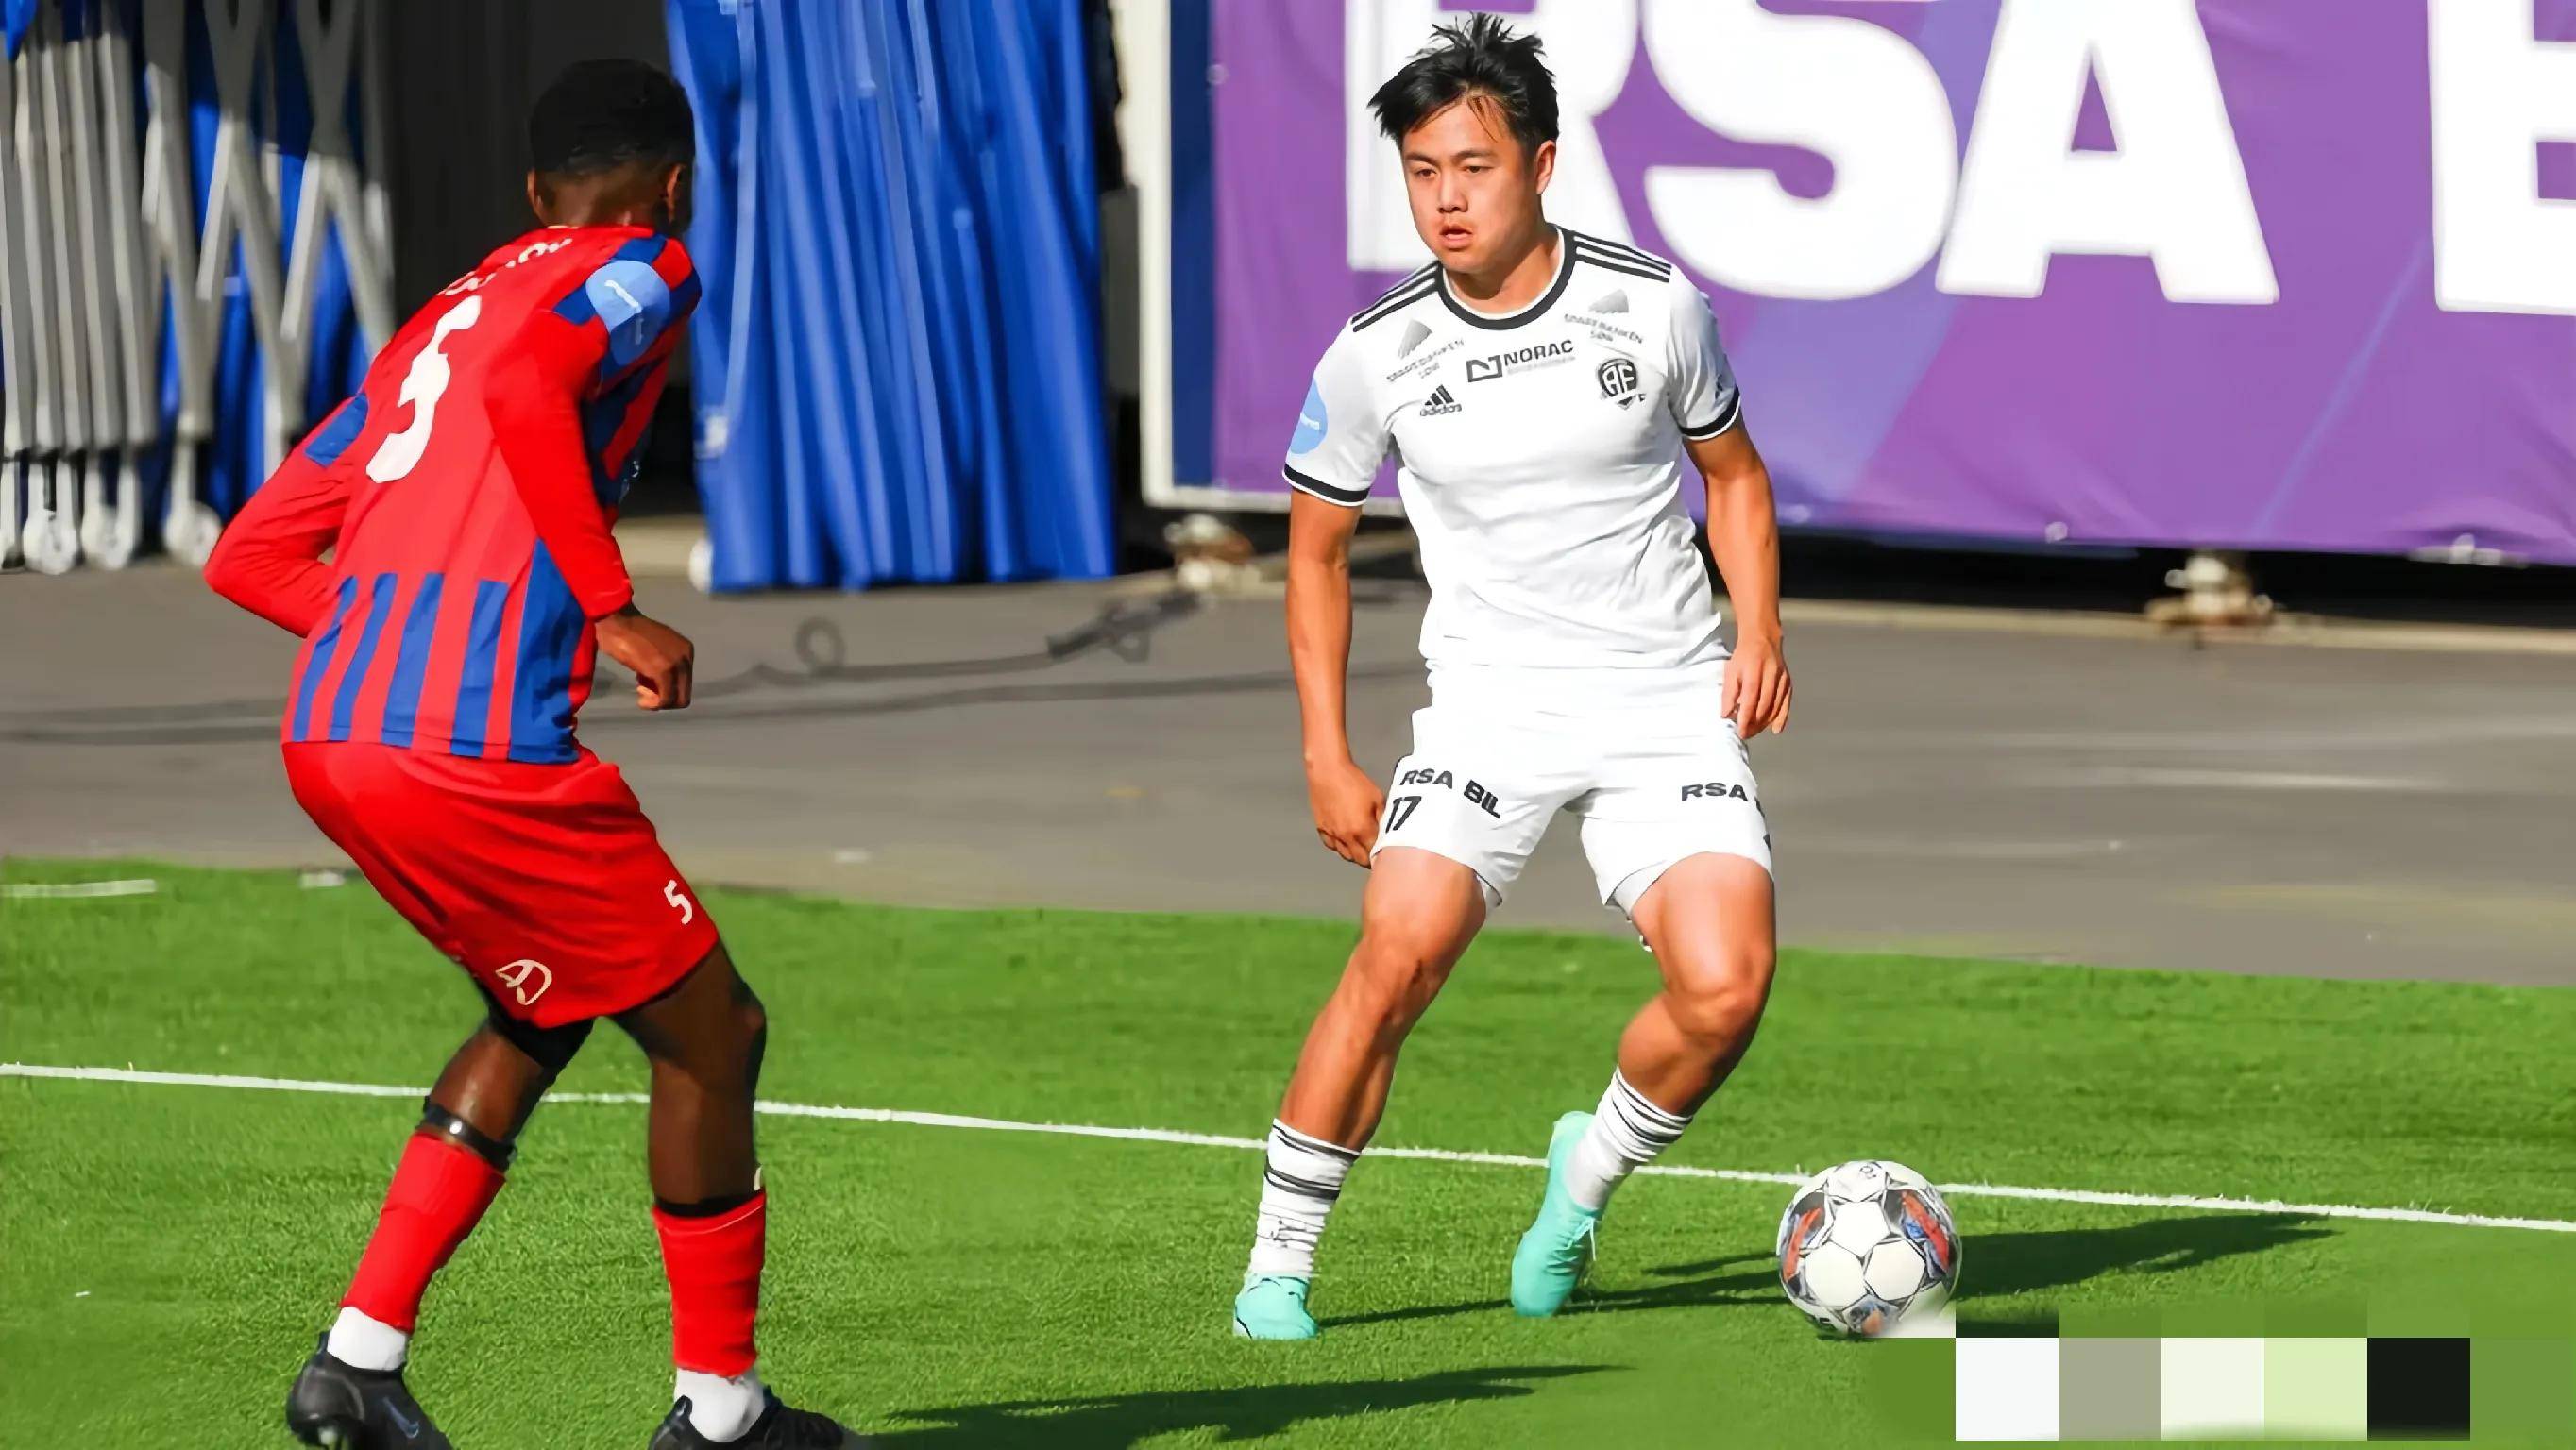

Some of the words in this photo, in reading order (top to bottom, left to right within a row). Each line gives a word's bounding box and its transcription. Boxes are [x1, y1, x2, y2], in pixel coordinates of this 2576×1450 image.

[1503, 339, 1573, 366] NORAC
[1419, 403, 1463, 417] adidas
[1399, 768, 1453, 789] RSA
[1464, 779, 1501, 819] BIL
[1681, 783, 1749, 801] RSA
[1385, 796, 1422, 834] 17
[663, 879, 693, 925] 5
